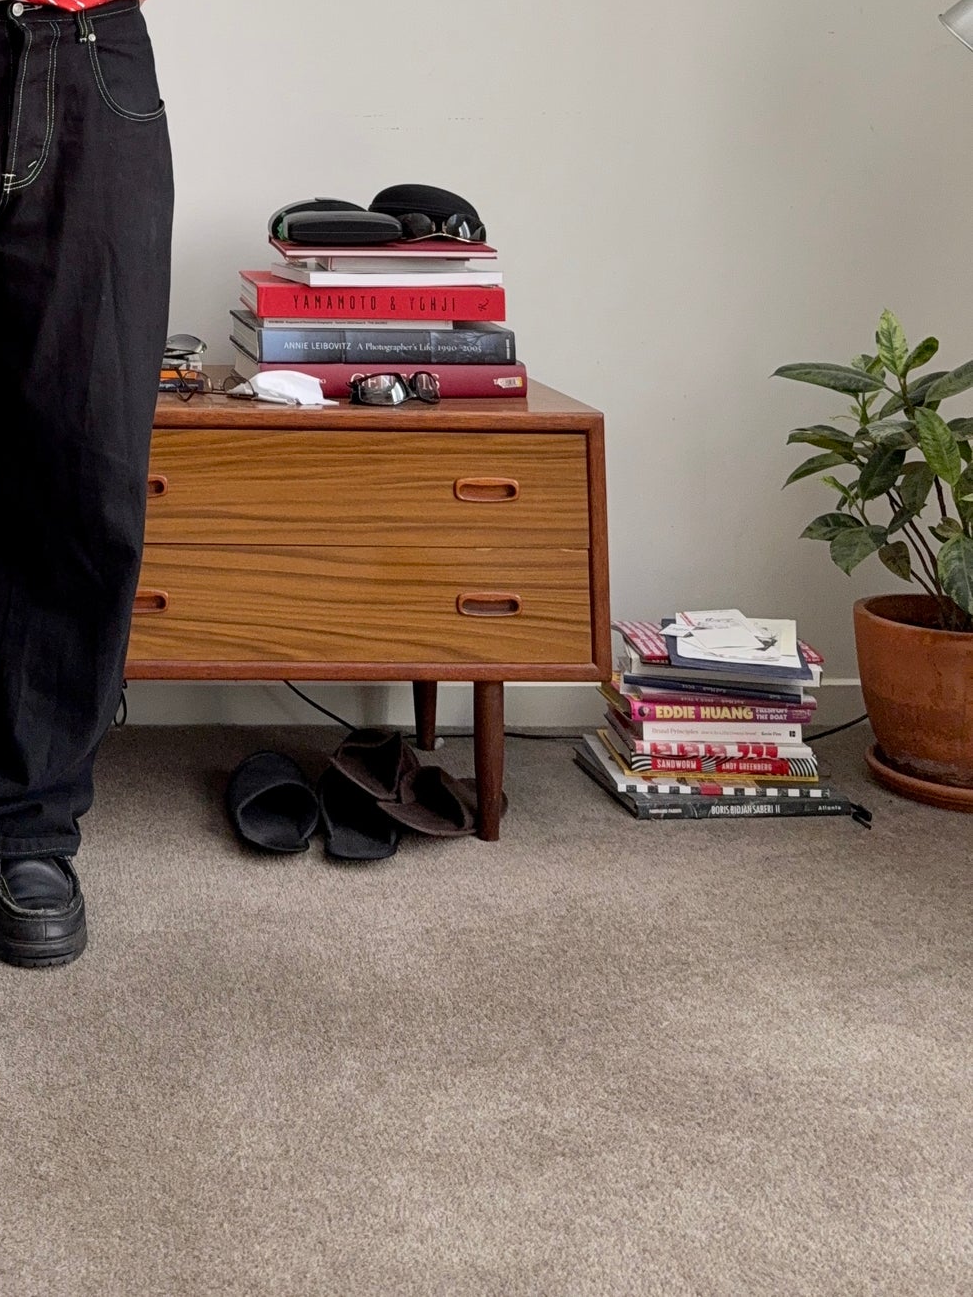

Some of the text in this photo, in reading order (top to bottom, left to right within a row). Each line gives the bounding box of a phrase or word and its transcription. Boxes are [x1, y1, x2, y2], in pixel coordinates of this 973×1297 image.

[293, 295, 376, 310] YAMAMOTO
[390, 296, 396, 310] &
[284, 342, 308, 350] ANNIE
[311, 342, 352, 350] LEIBOVITZ
[357, 343, 363, 351] A
[366, 342, 418, 354] Photographer's
[655, 705, 754, 720] EDDIE HUANG
[657, 759, 772, 771] SANDWORM ANDY GREENBERG
[711, 805, 729, 814] BORIS
[752, 804, 773, 814] SABERI
